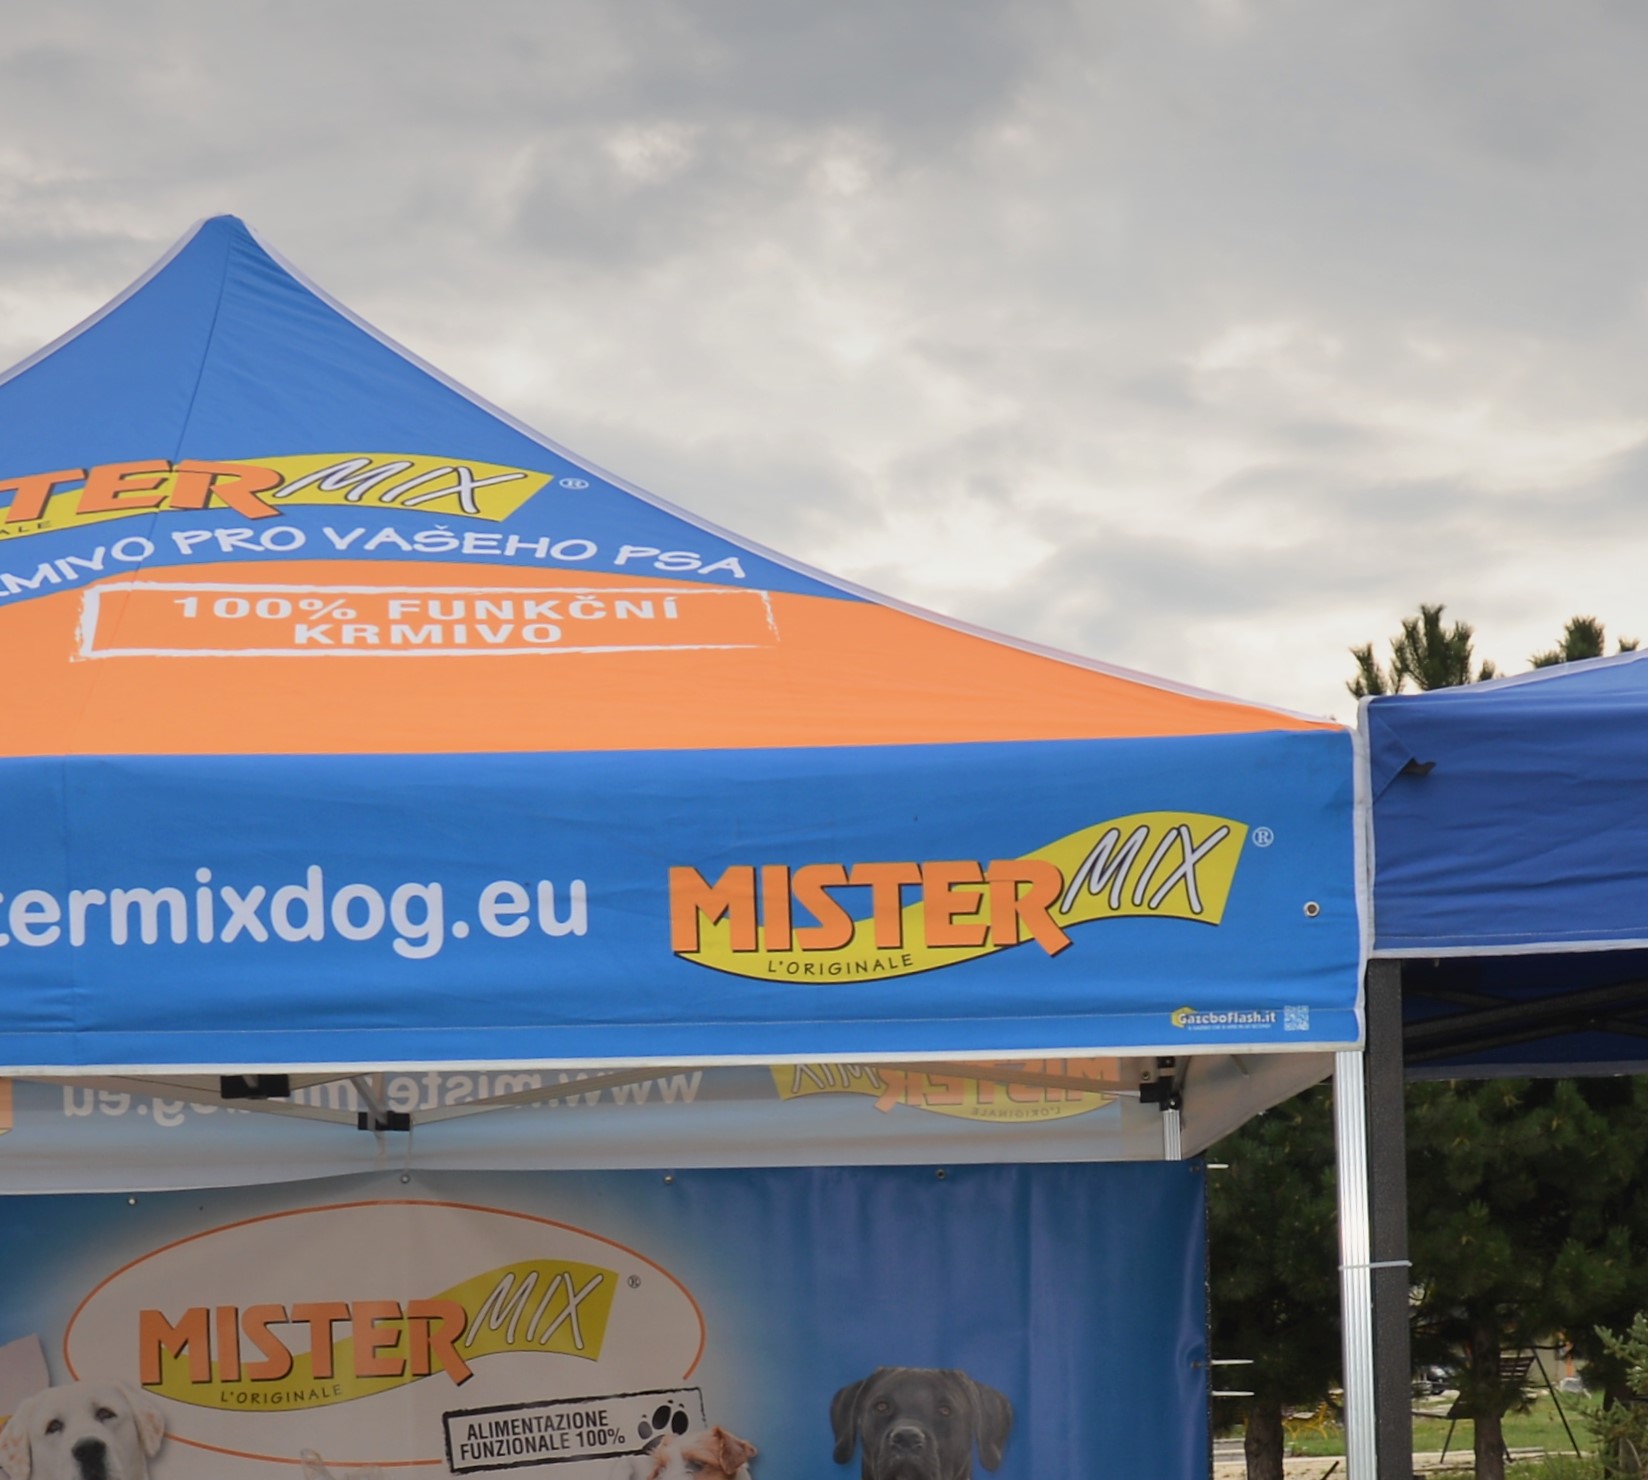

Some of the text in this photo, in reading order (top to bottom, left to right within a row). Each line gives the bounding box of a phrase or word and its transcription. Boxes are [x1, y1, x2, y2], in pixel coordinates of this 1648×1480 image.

[273, 456, 528, 515] MIX
[171, 526, 307, 556] PRO
[321, 523, 599, 562] VAŠEHO
[613, 545, 748, 579] PSA
[173, 594, 681, 620] 100% FUNKČNÍ
[293, 623, 563, 645] KRMIVO
[668, 823, 1230, 957] MISTER MIX
[766, 953, 914, 977] L'ORIGINALE
[139, 1270, 604, 1386] MISTER MIX
[220, 1384, 342, 1405] L'ORIGINALE
[465, 1409, 610, 1441] ALIMENTAZIONE
[459, 1427, 626, 1461] FUNZIONALE 100%
